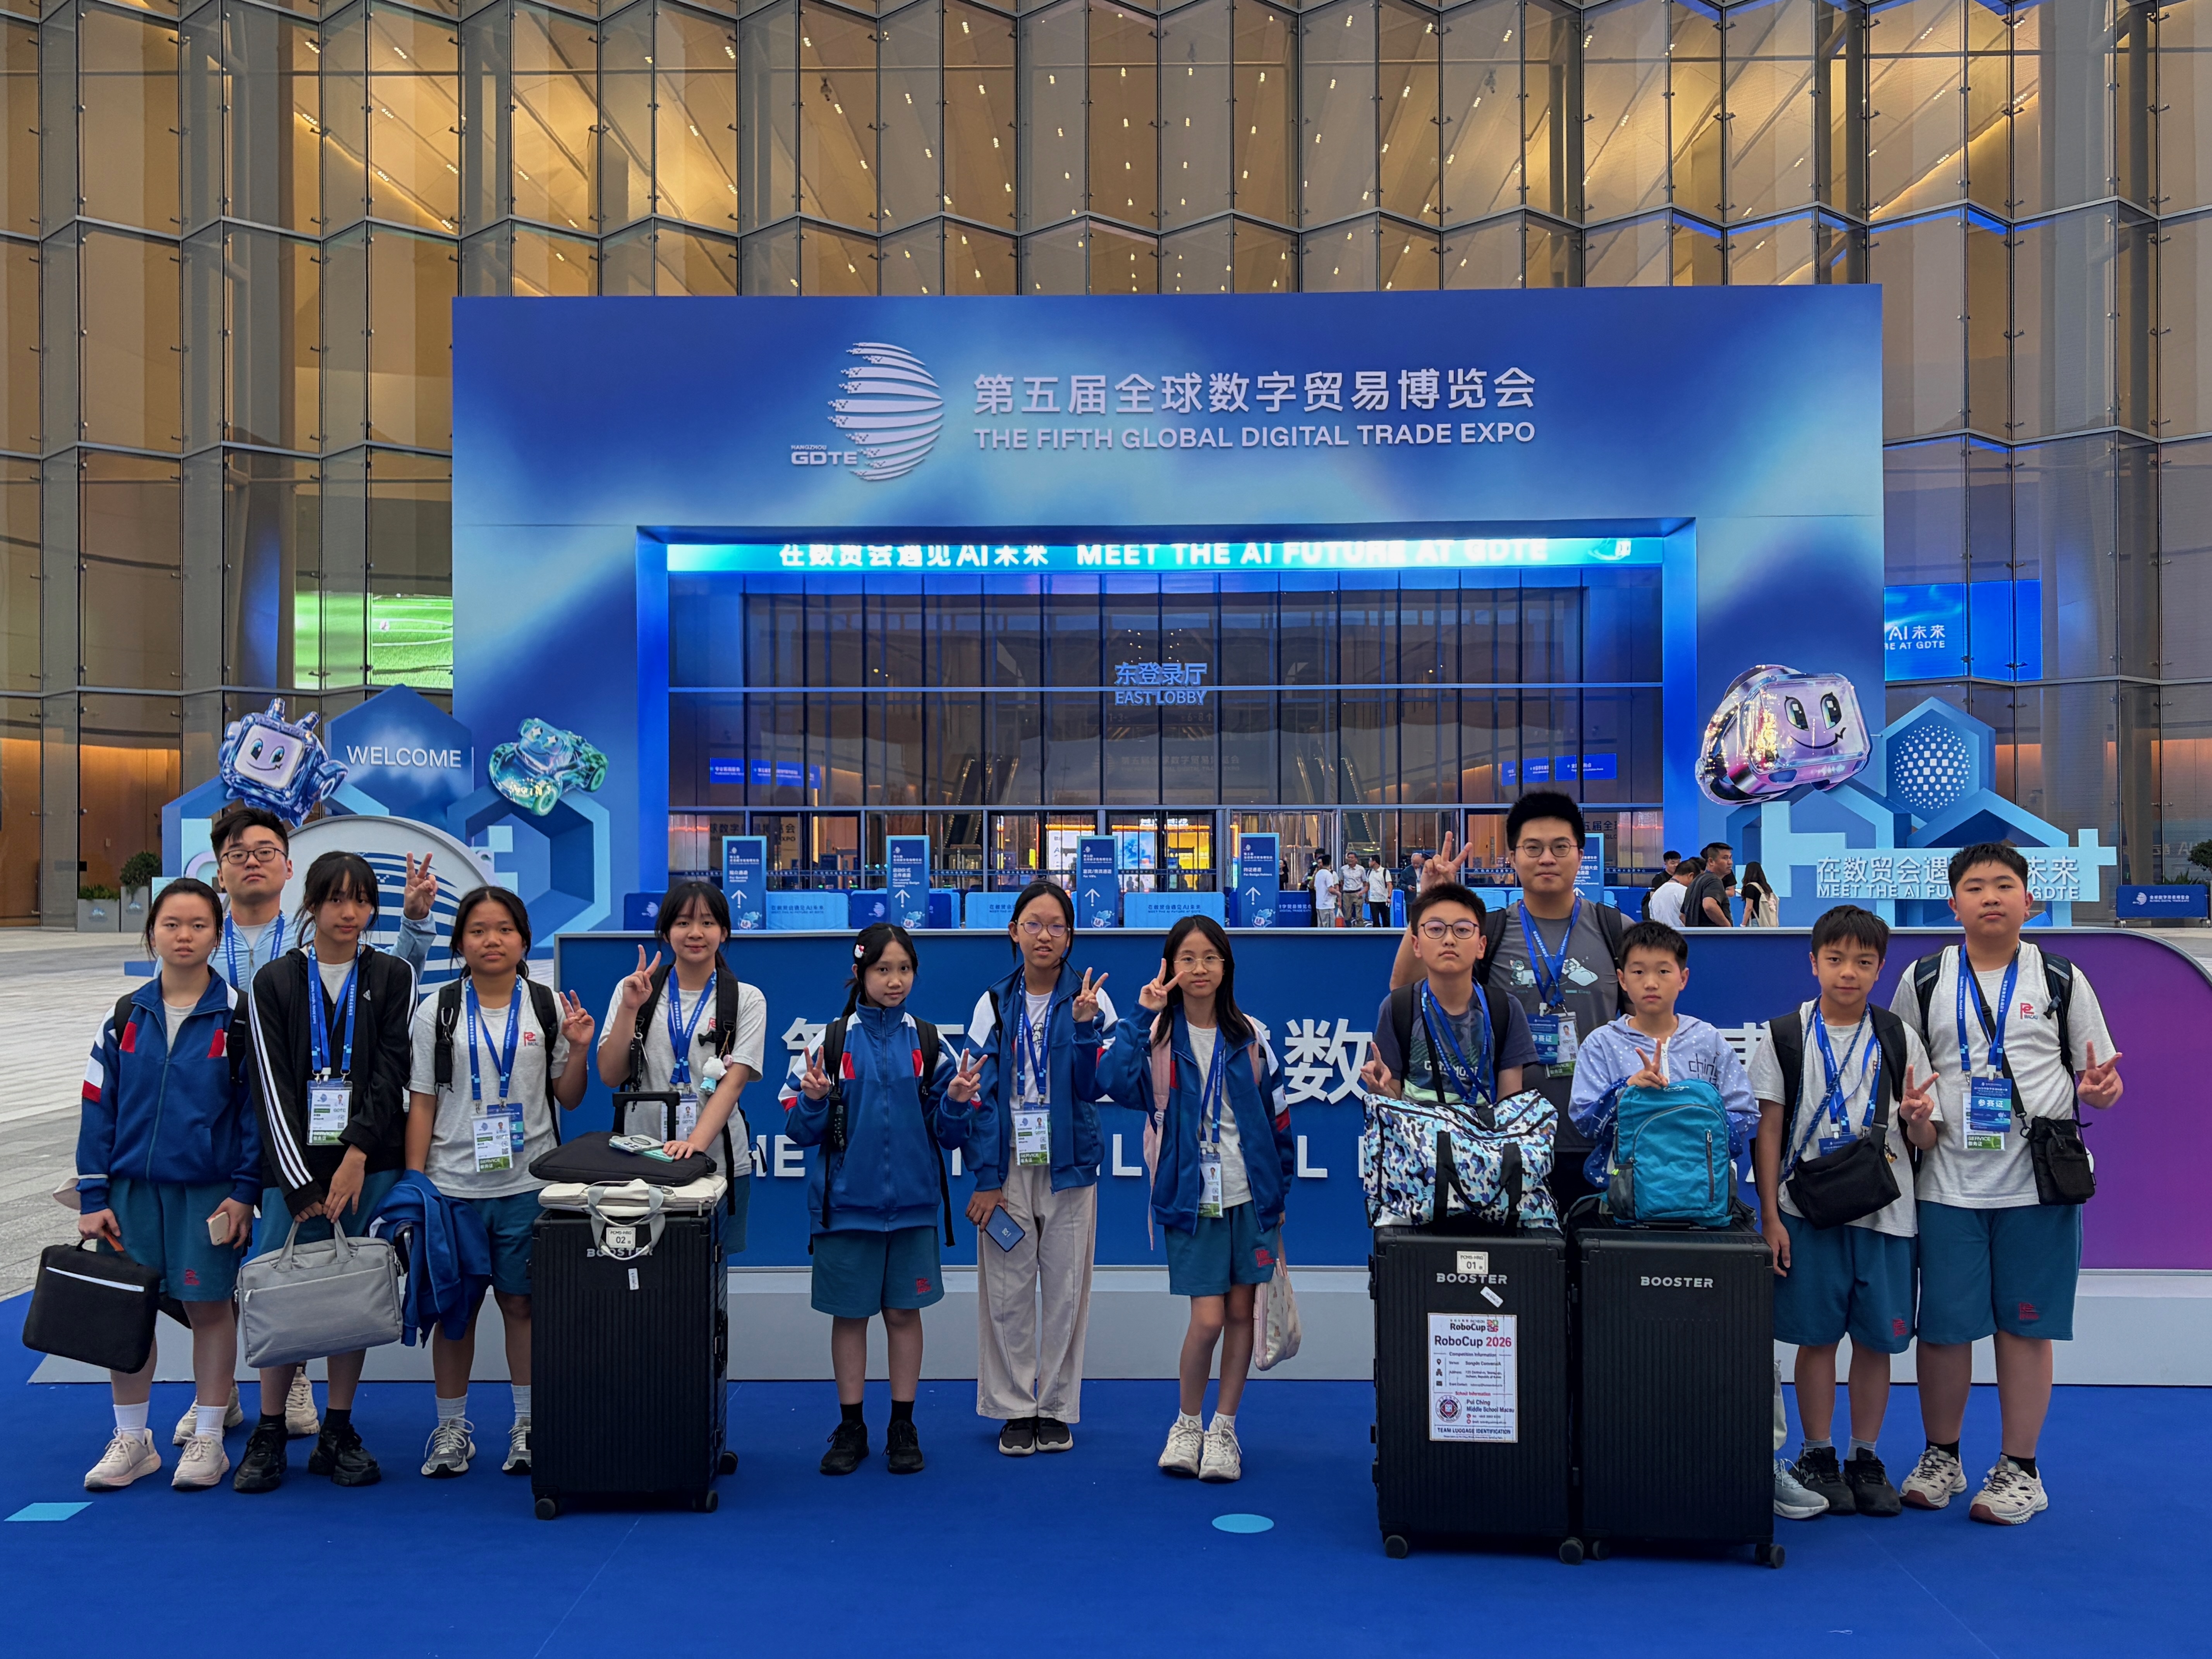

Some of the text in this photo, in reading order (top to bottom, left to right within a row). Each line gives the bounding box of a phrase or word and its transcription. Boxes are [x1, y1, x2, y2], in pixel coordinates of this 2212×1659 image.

[974, 367, 1535, 414] 第五届全球数字贸易博览会
[974, 422, 1535, 448] THE FIFTH GLOBAL DIGITAL TRADE EXPO
[791, 451, 857, 465] GDTE
[1077, 544, 1158, 566] MEET
[1174, 543, 1231, 565] THE
[1240, 543, 1271, 564] AI
[1283, 541, 1407, 564] FUTURE
[1916, 641, 1945, 649] GDTE
[1114, 662, 1207, 686] 东登录厅
[1115, 690, 1207, 706] EAST LOBBY
[346, 745, 461, 768] WELCOME
[1819, 884, 1861, 897] MEET
[1867, 885, 1898, 897] THE
[1905, 885, 1920, 898] AI
[1467, 1261, 1476, 1269] 01
[1436, 1273, 1507, 1285] BOOSTER
[1640, 1276, 1714, 1288] BOOSTER
[1450, 1323, 1486, 1332] RoboCup
[1434, 1335, 1512, 1348] RoboCup 2026
